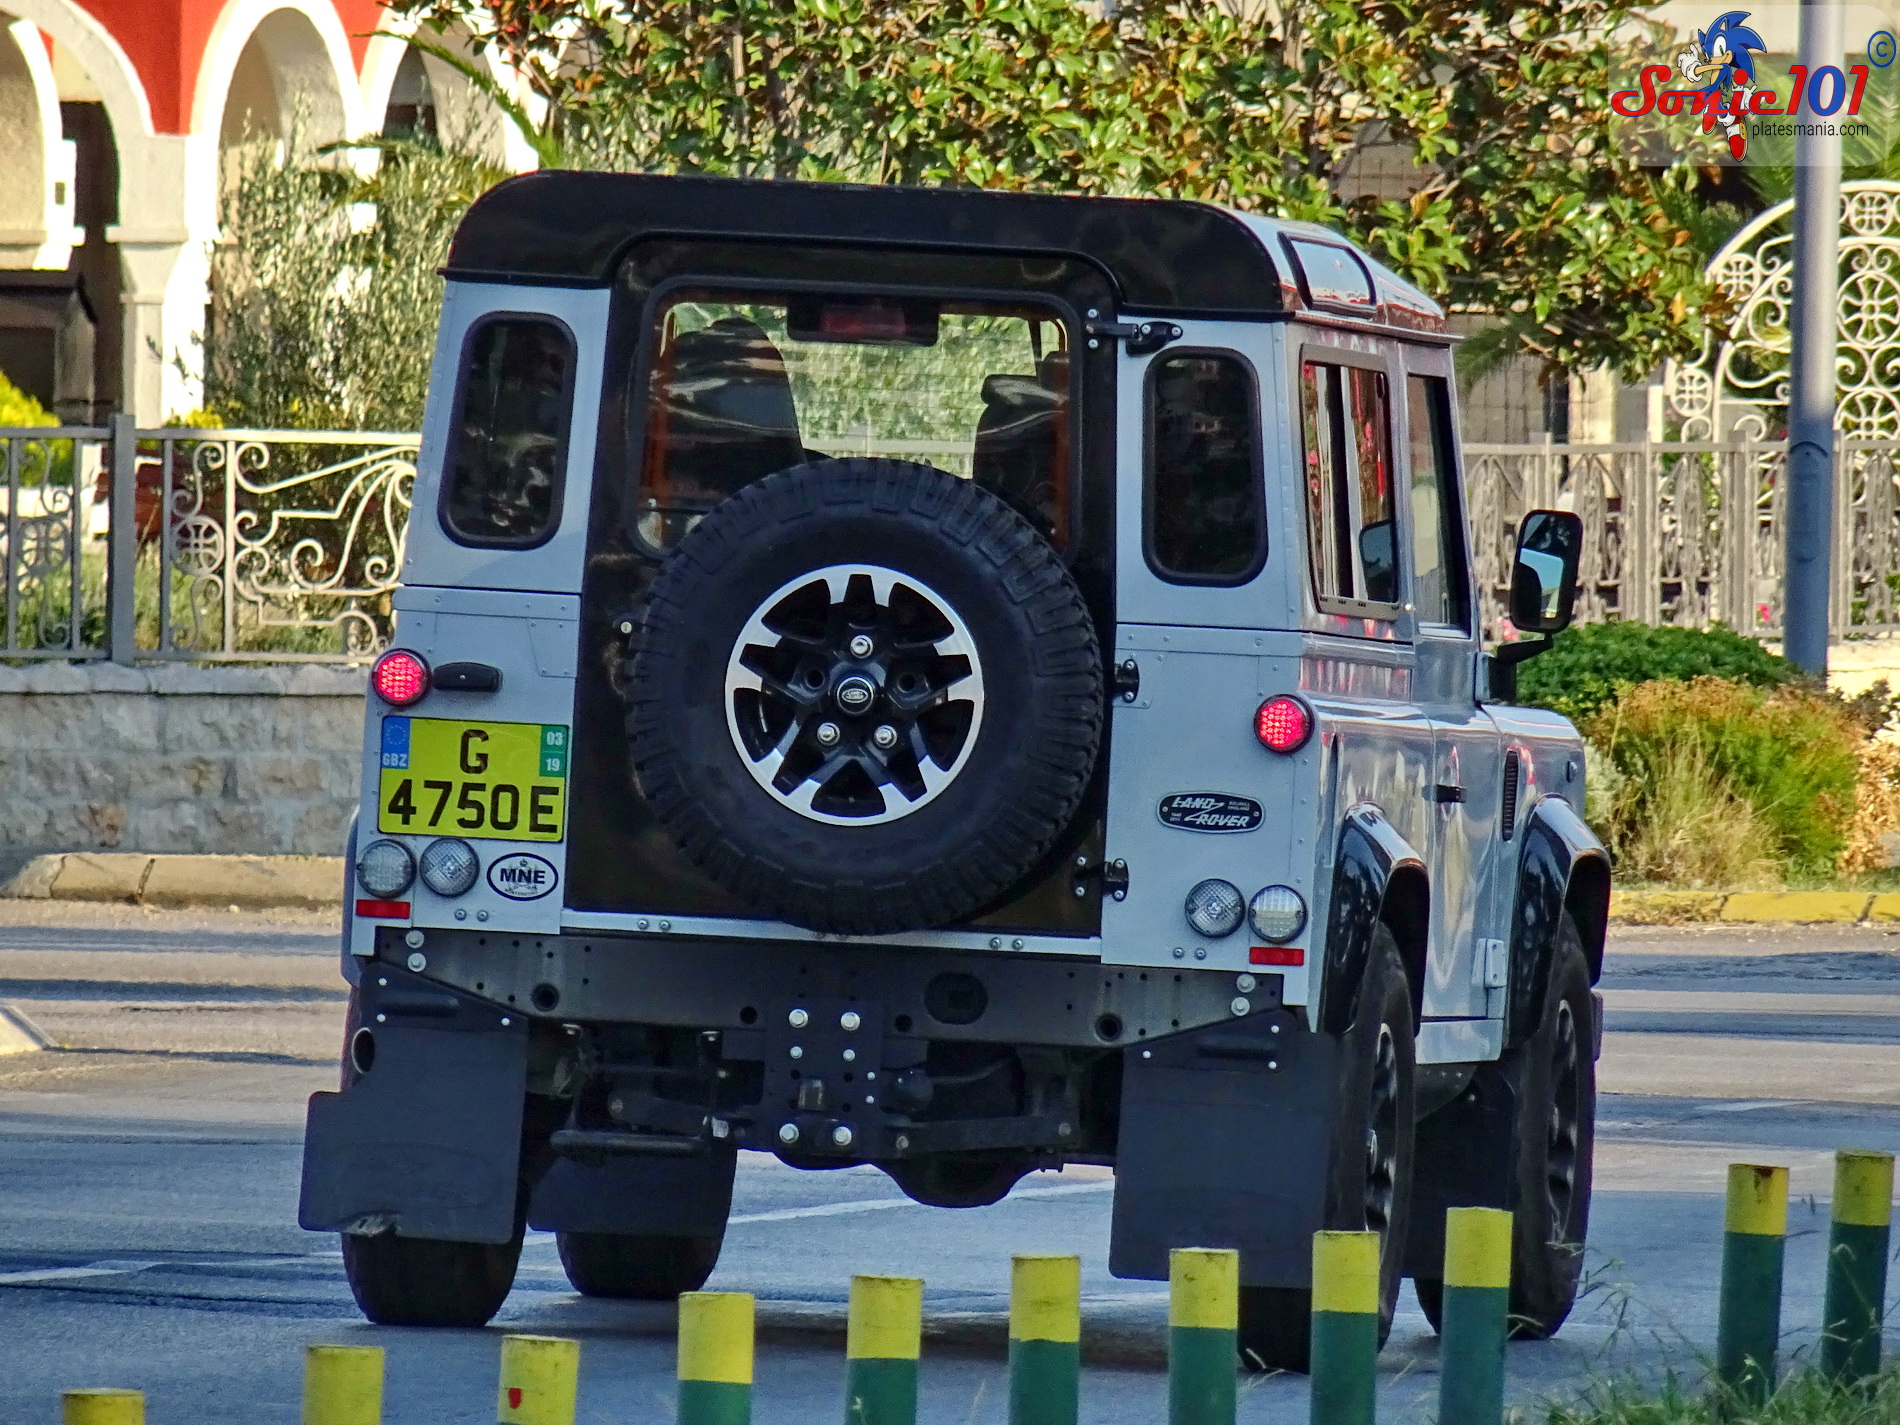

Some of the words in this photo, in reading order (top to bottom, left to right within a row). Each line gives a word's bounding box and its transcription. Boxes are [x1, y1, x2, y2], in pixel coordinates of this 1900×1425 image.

[546, 731, 563, 746] 03
[459, 729, 490, 774] G
[382, 753, 408, 767] GBZ
[546, 758, 561, 772] 19
[387, 778, 560, 834] 4750E
[1171, 797, 1216, 809] LAND
[1195, 814, 1250, 827] ROVER
[500, 867, 546, 885] MNE
